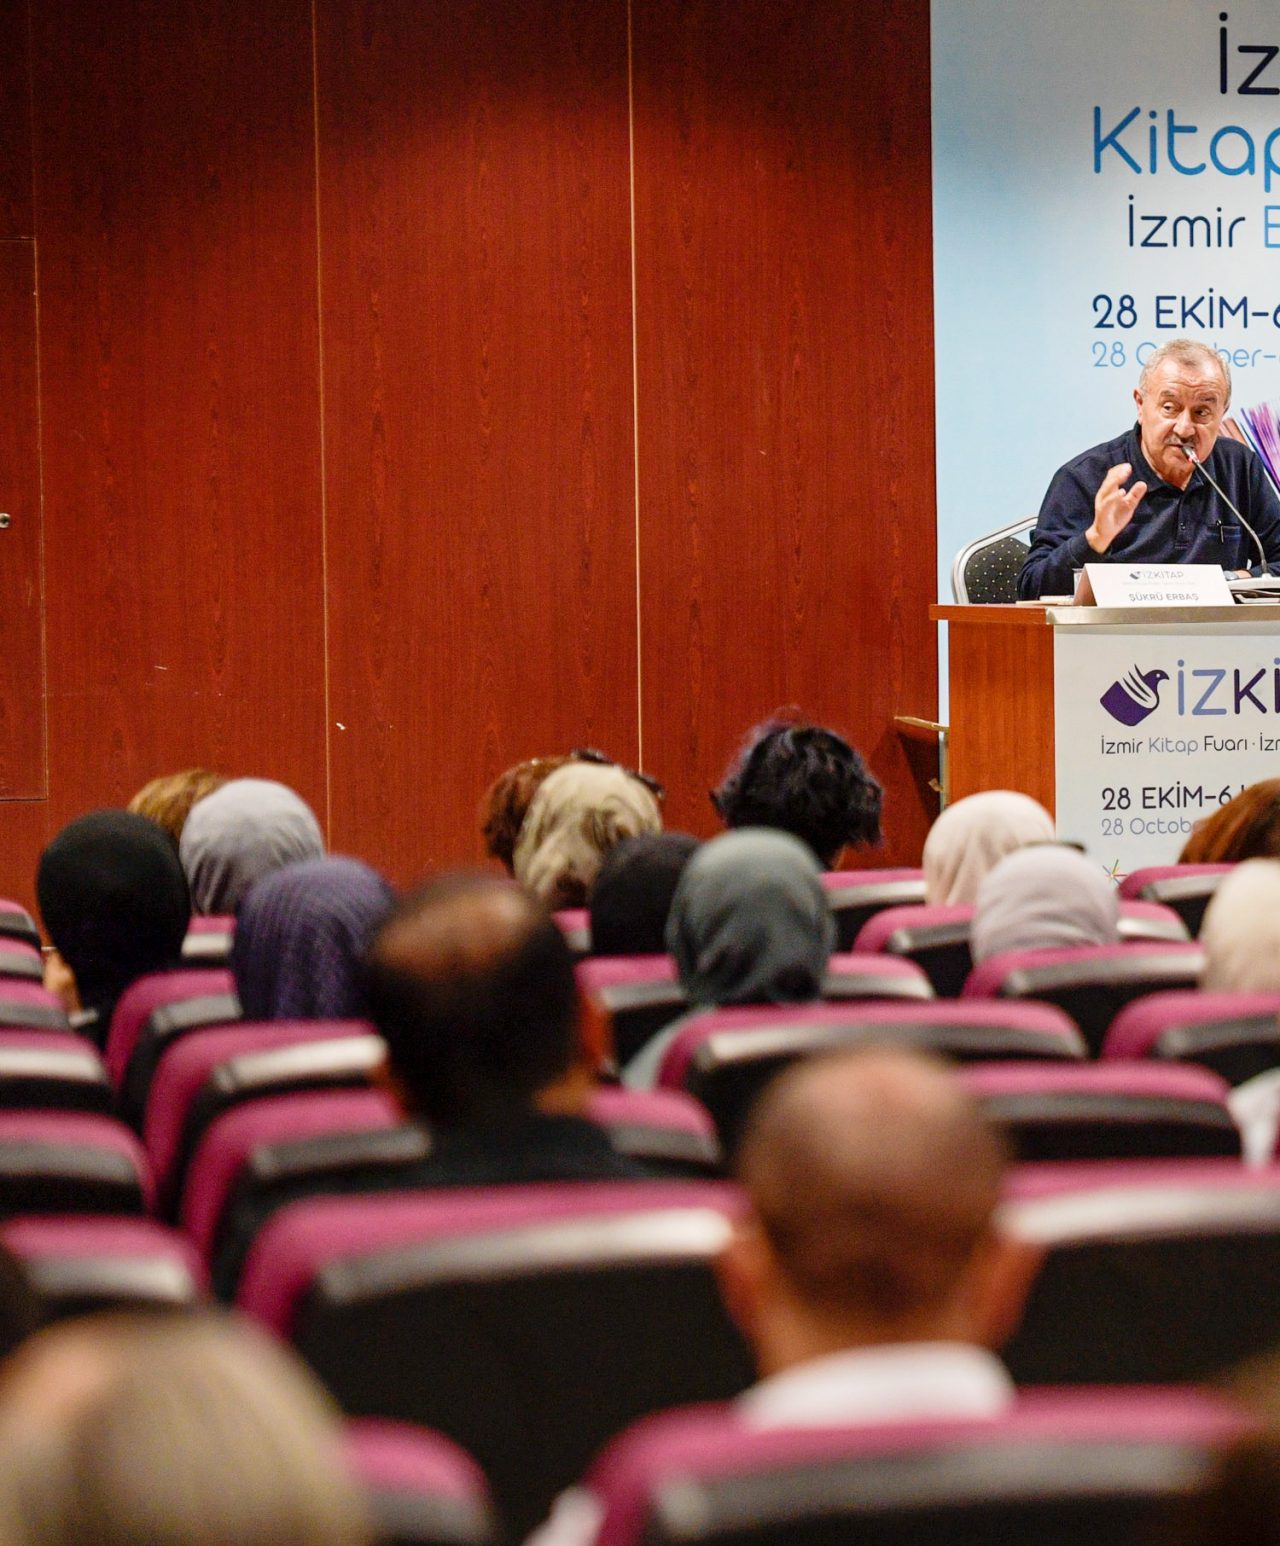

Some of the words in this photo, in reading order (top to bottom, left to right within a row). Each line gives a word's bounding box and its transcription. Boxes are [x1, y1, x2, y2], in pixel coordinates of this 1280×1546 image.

[1128, 194, 1245, 247] İzmir
[1093, 294, 1137, 328] 28
[1092, 341, 1126, 367] 28
[1101, 735, 1143, 754] İzmir
[1149, 737, 1198, 756] Kitap
[1204, 736, 1247, 751] Fuarı
[1102, 787, 1131, 810] 28
[1102, 818, 1123, 836] 28
